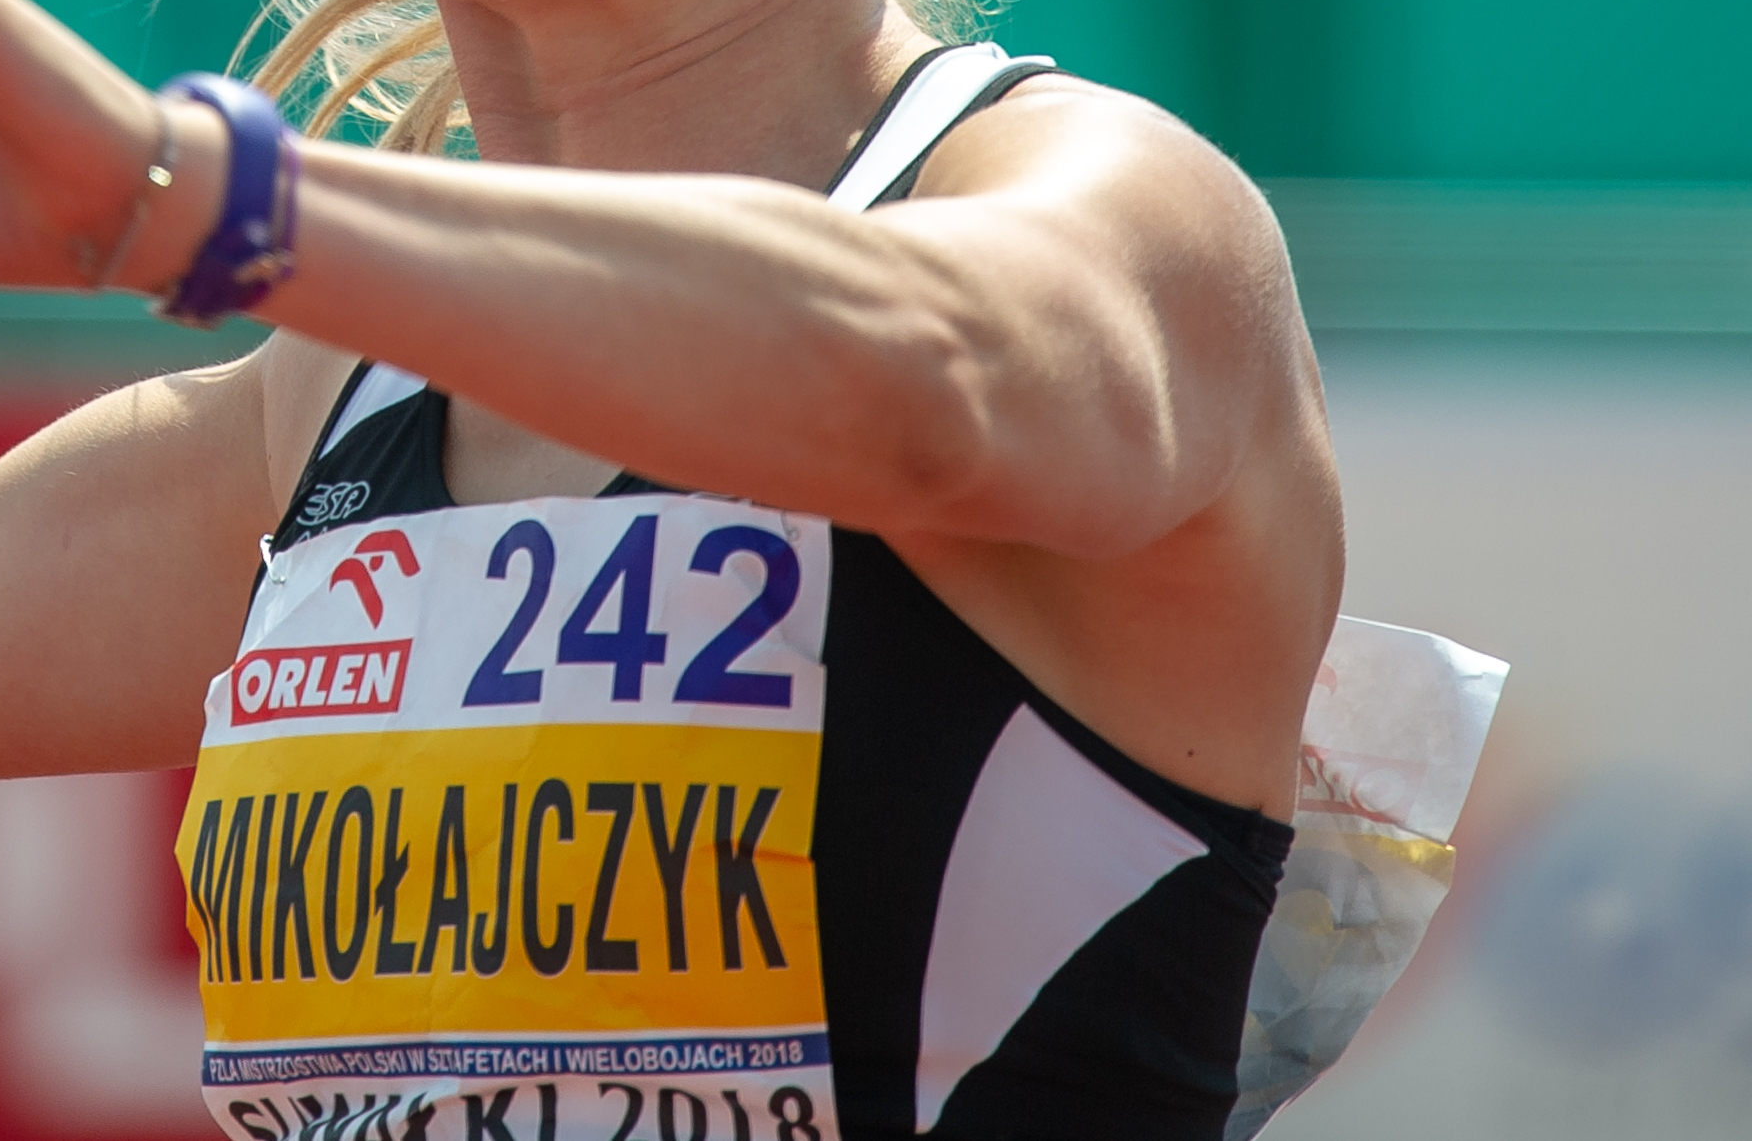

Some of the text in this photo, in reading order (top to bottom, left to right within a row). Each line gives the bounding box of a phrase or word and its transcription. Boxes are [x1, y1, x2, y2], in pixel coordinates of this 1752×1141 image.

[461, 514, 802, 710] 242
[237, 650, 401, 714] ORLEN
[191, 778, 790, 983] MIKOŁAJCZYK
[208, 1057, 241, 1082] PZLA
[342, 1049, 407, 1074] POLSKI
[406, 1048, 426, 1073] W
[553, 1047, 562, 1072] I
[565, 1043, 745, 1073] WIELOBOJACH
[748, 1041, 805, 1067] 2018
